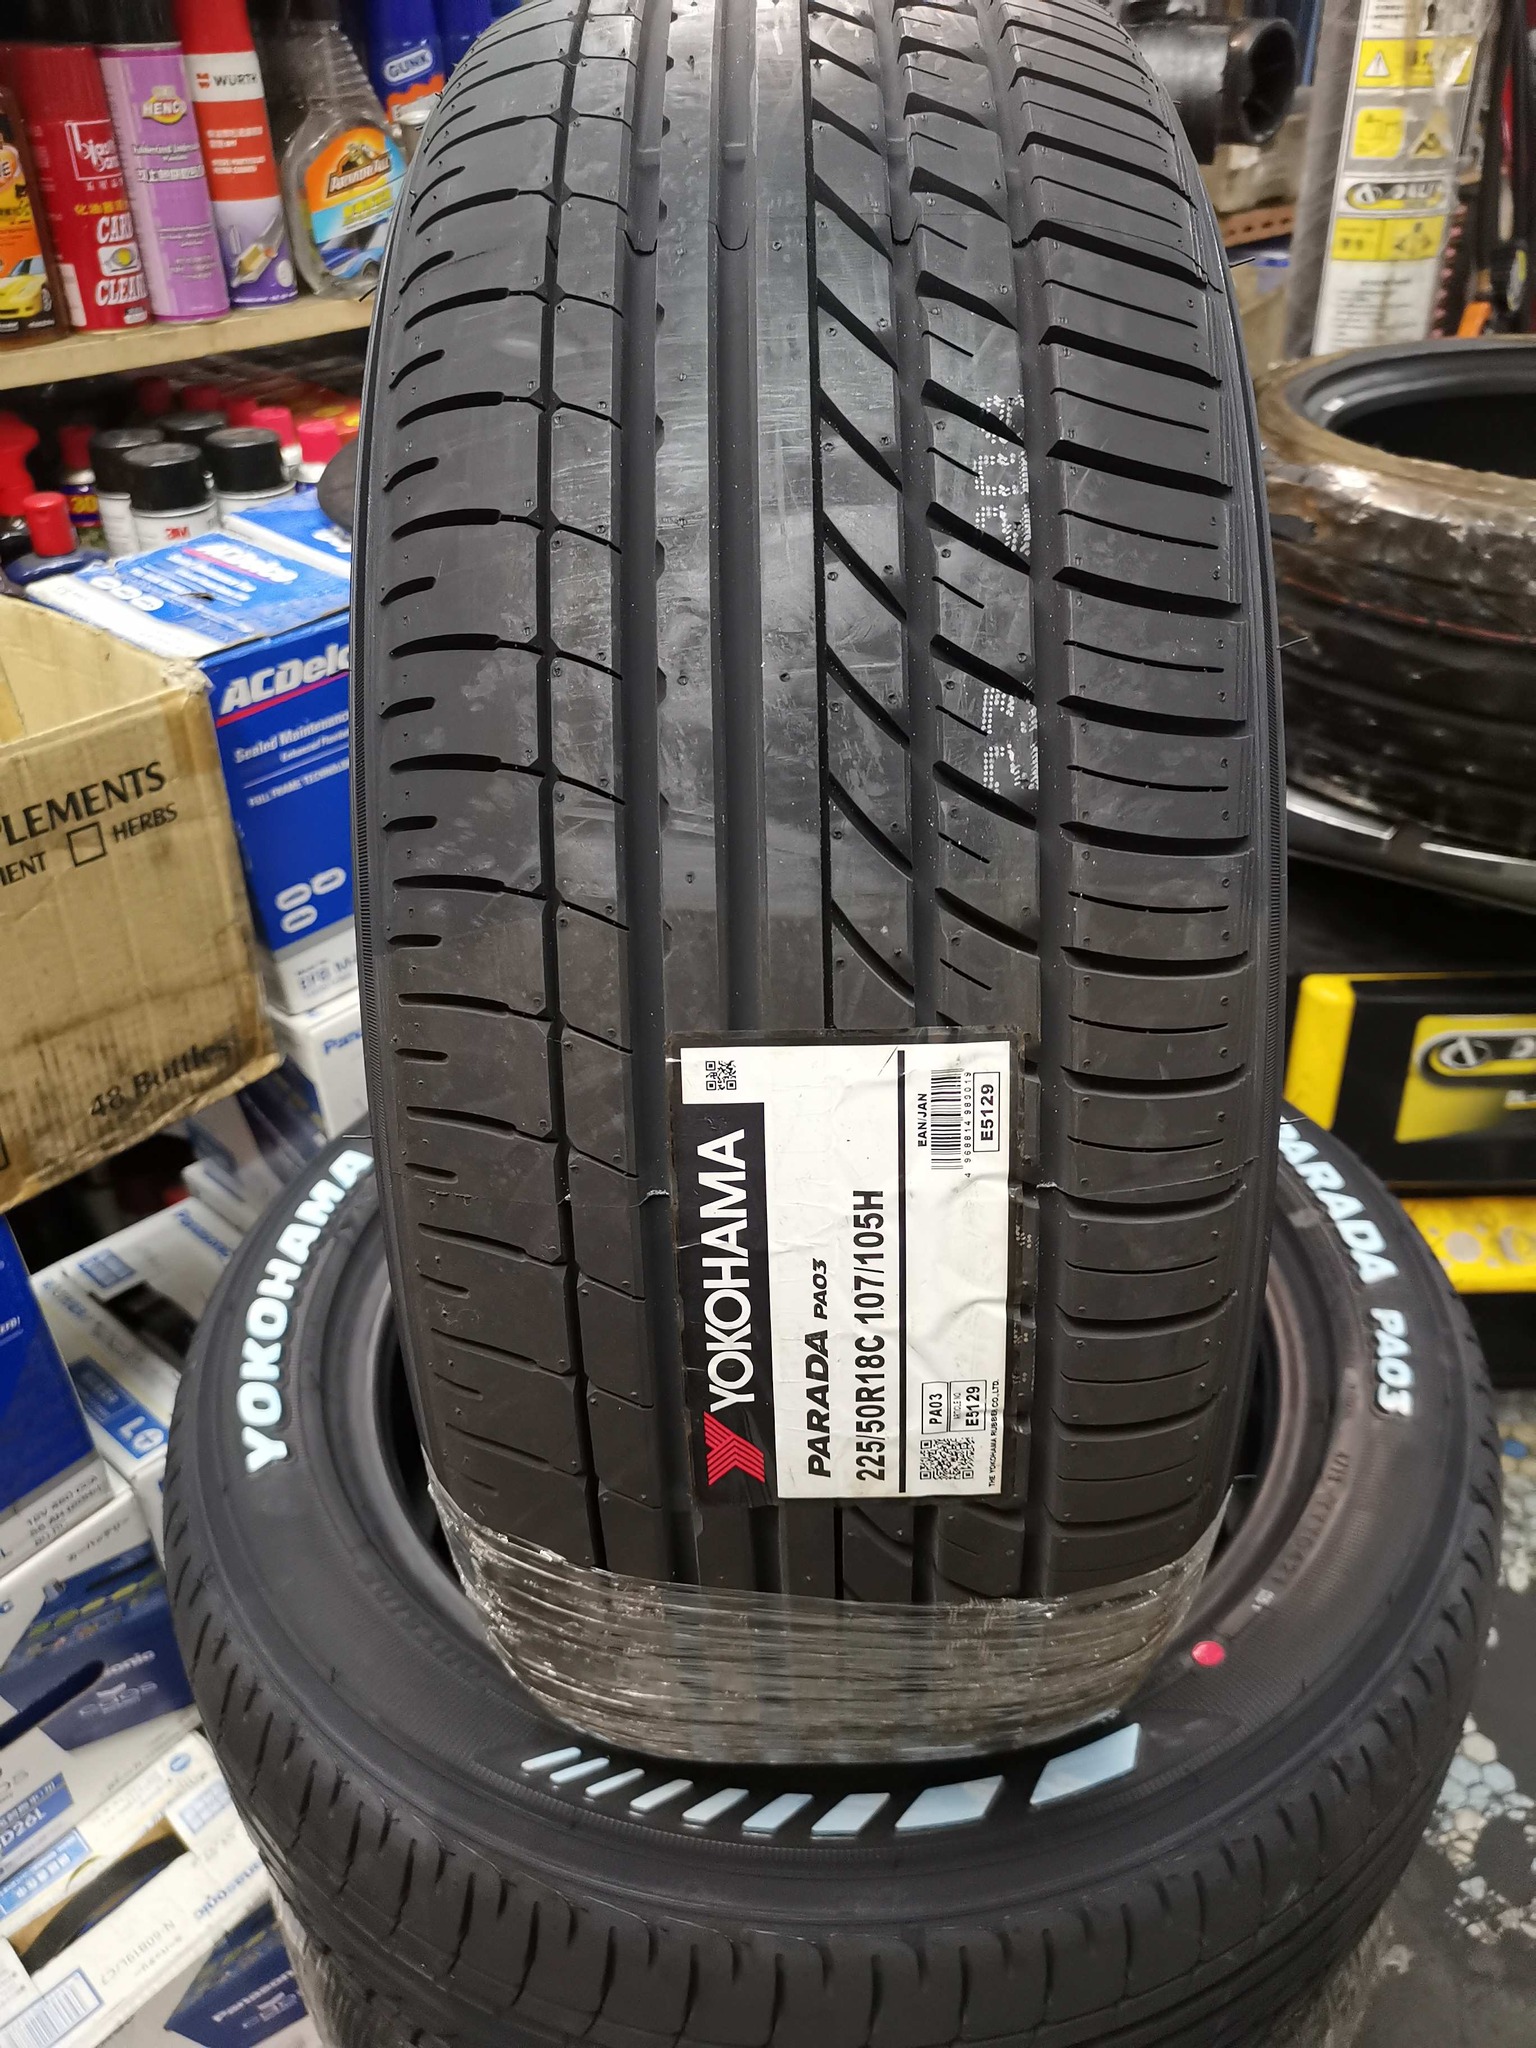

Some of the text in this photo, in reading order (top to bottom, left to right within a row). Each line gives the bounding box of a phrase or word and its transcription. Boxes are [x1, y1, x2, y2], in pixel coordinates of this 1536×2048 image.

[165, 526, 190, 541] 3M
[0, 761, 166, 846] LEMENTS
[113, 804, 178, 843] HERBS
[91, 1084, 127, 1117] 48
[917, 1093, 928, 1147] EAN/JAN
[979, 1083, 994, 1142] E5129
[697, 1128, 756, 1412] YOKOHAMA
[236, 1149, 375, 1474] YOKOHAMA
[853, 1190, 886, 1482] 225/50R18C 107/105H
[805, 1258, 831, 1478] PARADA PA03
[1369, 1307, 1417, 1416] PA03
[929, 1392, 943, 1425] PA03
[965, 1386, 980, 1427] E5129
[989, 1408, 998, 1436] RUBBER
[988, 1438, 997, 1473] YOKOHAMA
[988, 1475, 996, 1487] THE
